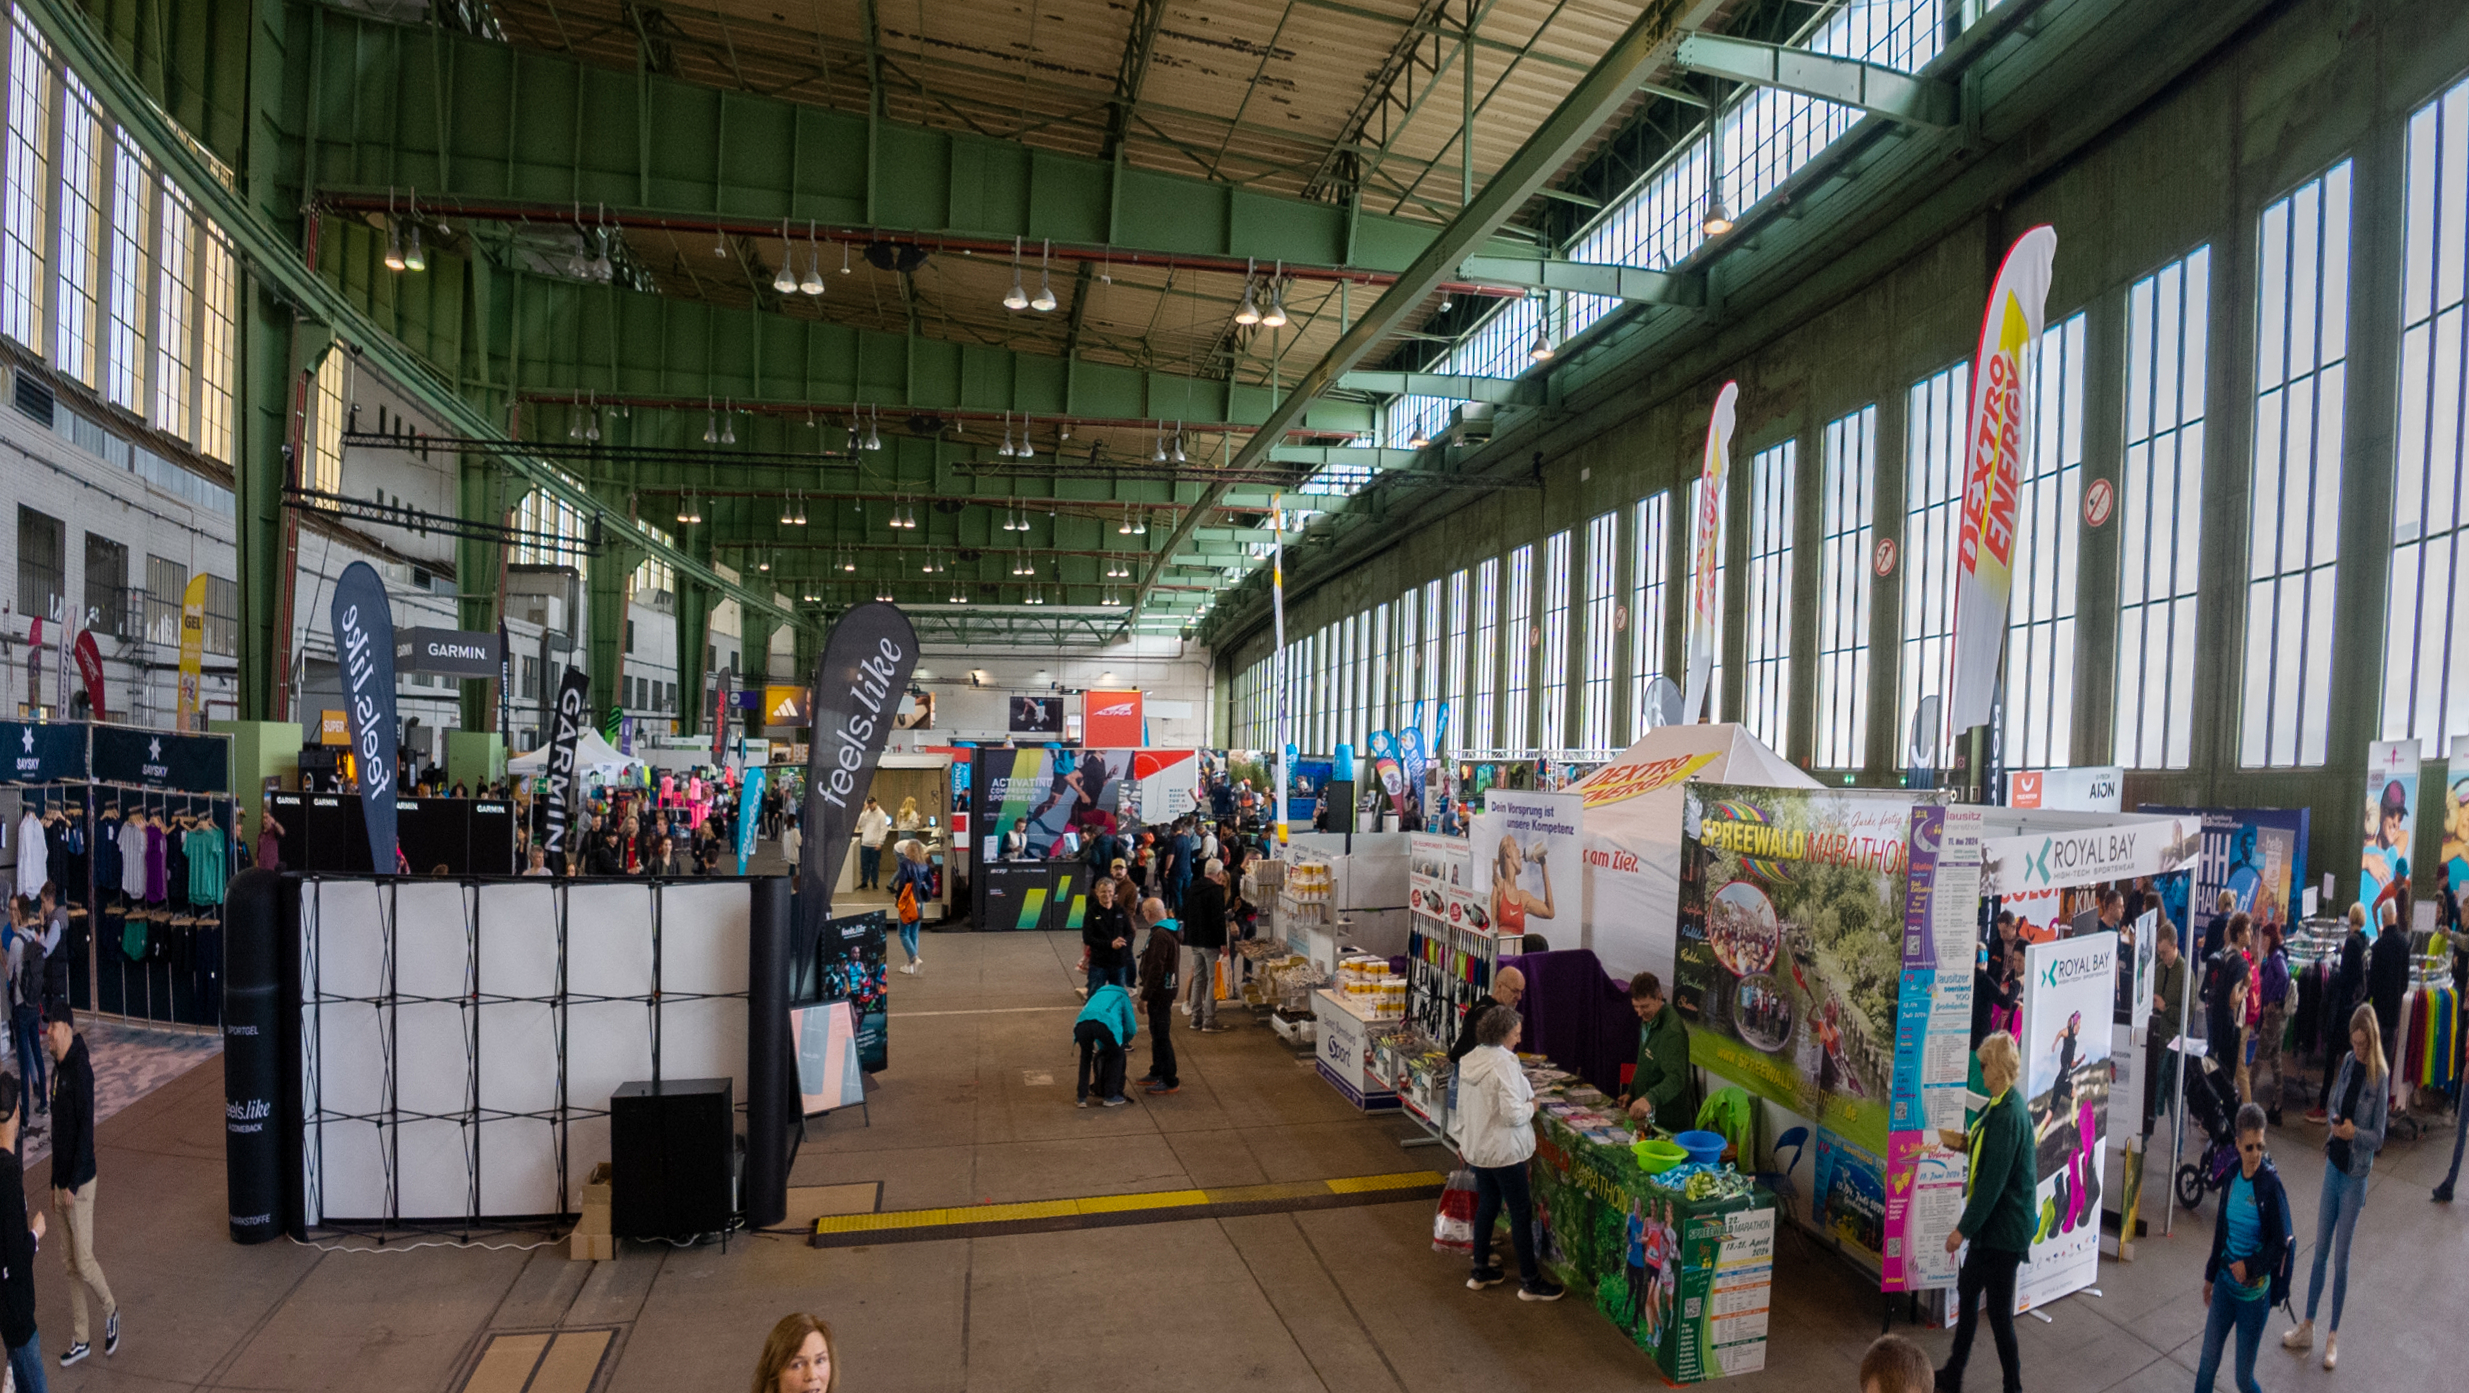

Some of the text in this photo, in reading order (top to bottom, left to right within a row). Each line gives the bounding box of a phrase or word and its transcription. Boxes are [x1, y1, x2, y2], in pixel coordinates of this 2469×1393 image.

[1961, 354, 2005, 578] DEXTRO
[1984, 351, 2021, 570] ENERGY
[184, 615, 201, 630] GEL
[428, 642, 487, 660] GARMIN
[323, 720, 344, 733] SUPER
[817, 637, 902, 808] feels.like
[16, 758, 40, 771] SAYSKY
[142, 764, 169, 778] SAYSKY
[544, 687, 581, 853] GARMIN
[1582, 754, 1693, 789] DEXTRO
[313, 798, 339, 807] GARMIN
[396, 802, 419, 811] ARMIN
[476, 804, 506, 814] GARMIN
[1491, 801, 1554, 818] Dein Vorsprung ist
[739, 776, 763, 864] soundcore
[1946, 811, 1981, 821] lausitz
[1506, 818, 1574, 835] unsere Kompetenz
[1701, 819, 1909, 877] SPREEWALD MARATHON
[2054, 833, 2136, 869] ROYAL BAY
[1590, 851, 1609, 867] am
[2059, 951, 2110, 978] ROYAL BAY
[1328, 1034, 1351, 1068] Sport
[226, 1099, 271, 1120] eels.like
[1569, 1157, 1630, 1215] MARATHON
[1688, 1220, 1771, 1240] SPREEWALD MARATHON
[1729, 1216, 1740, 1225] 22.
